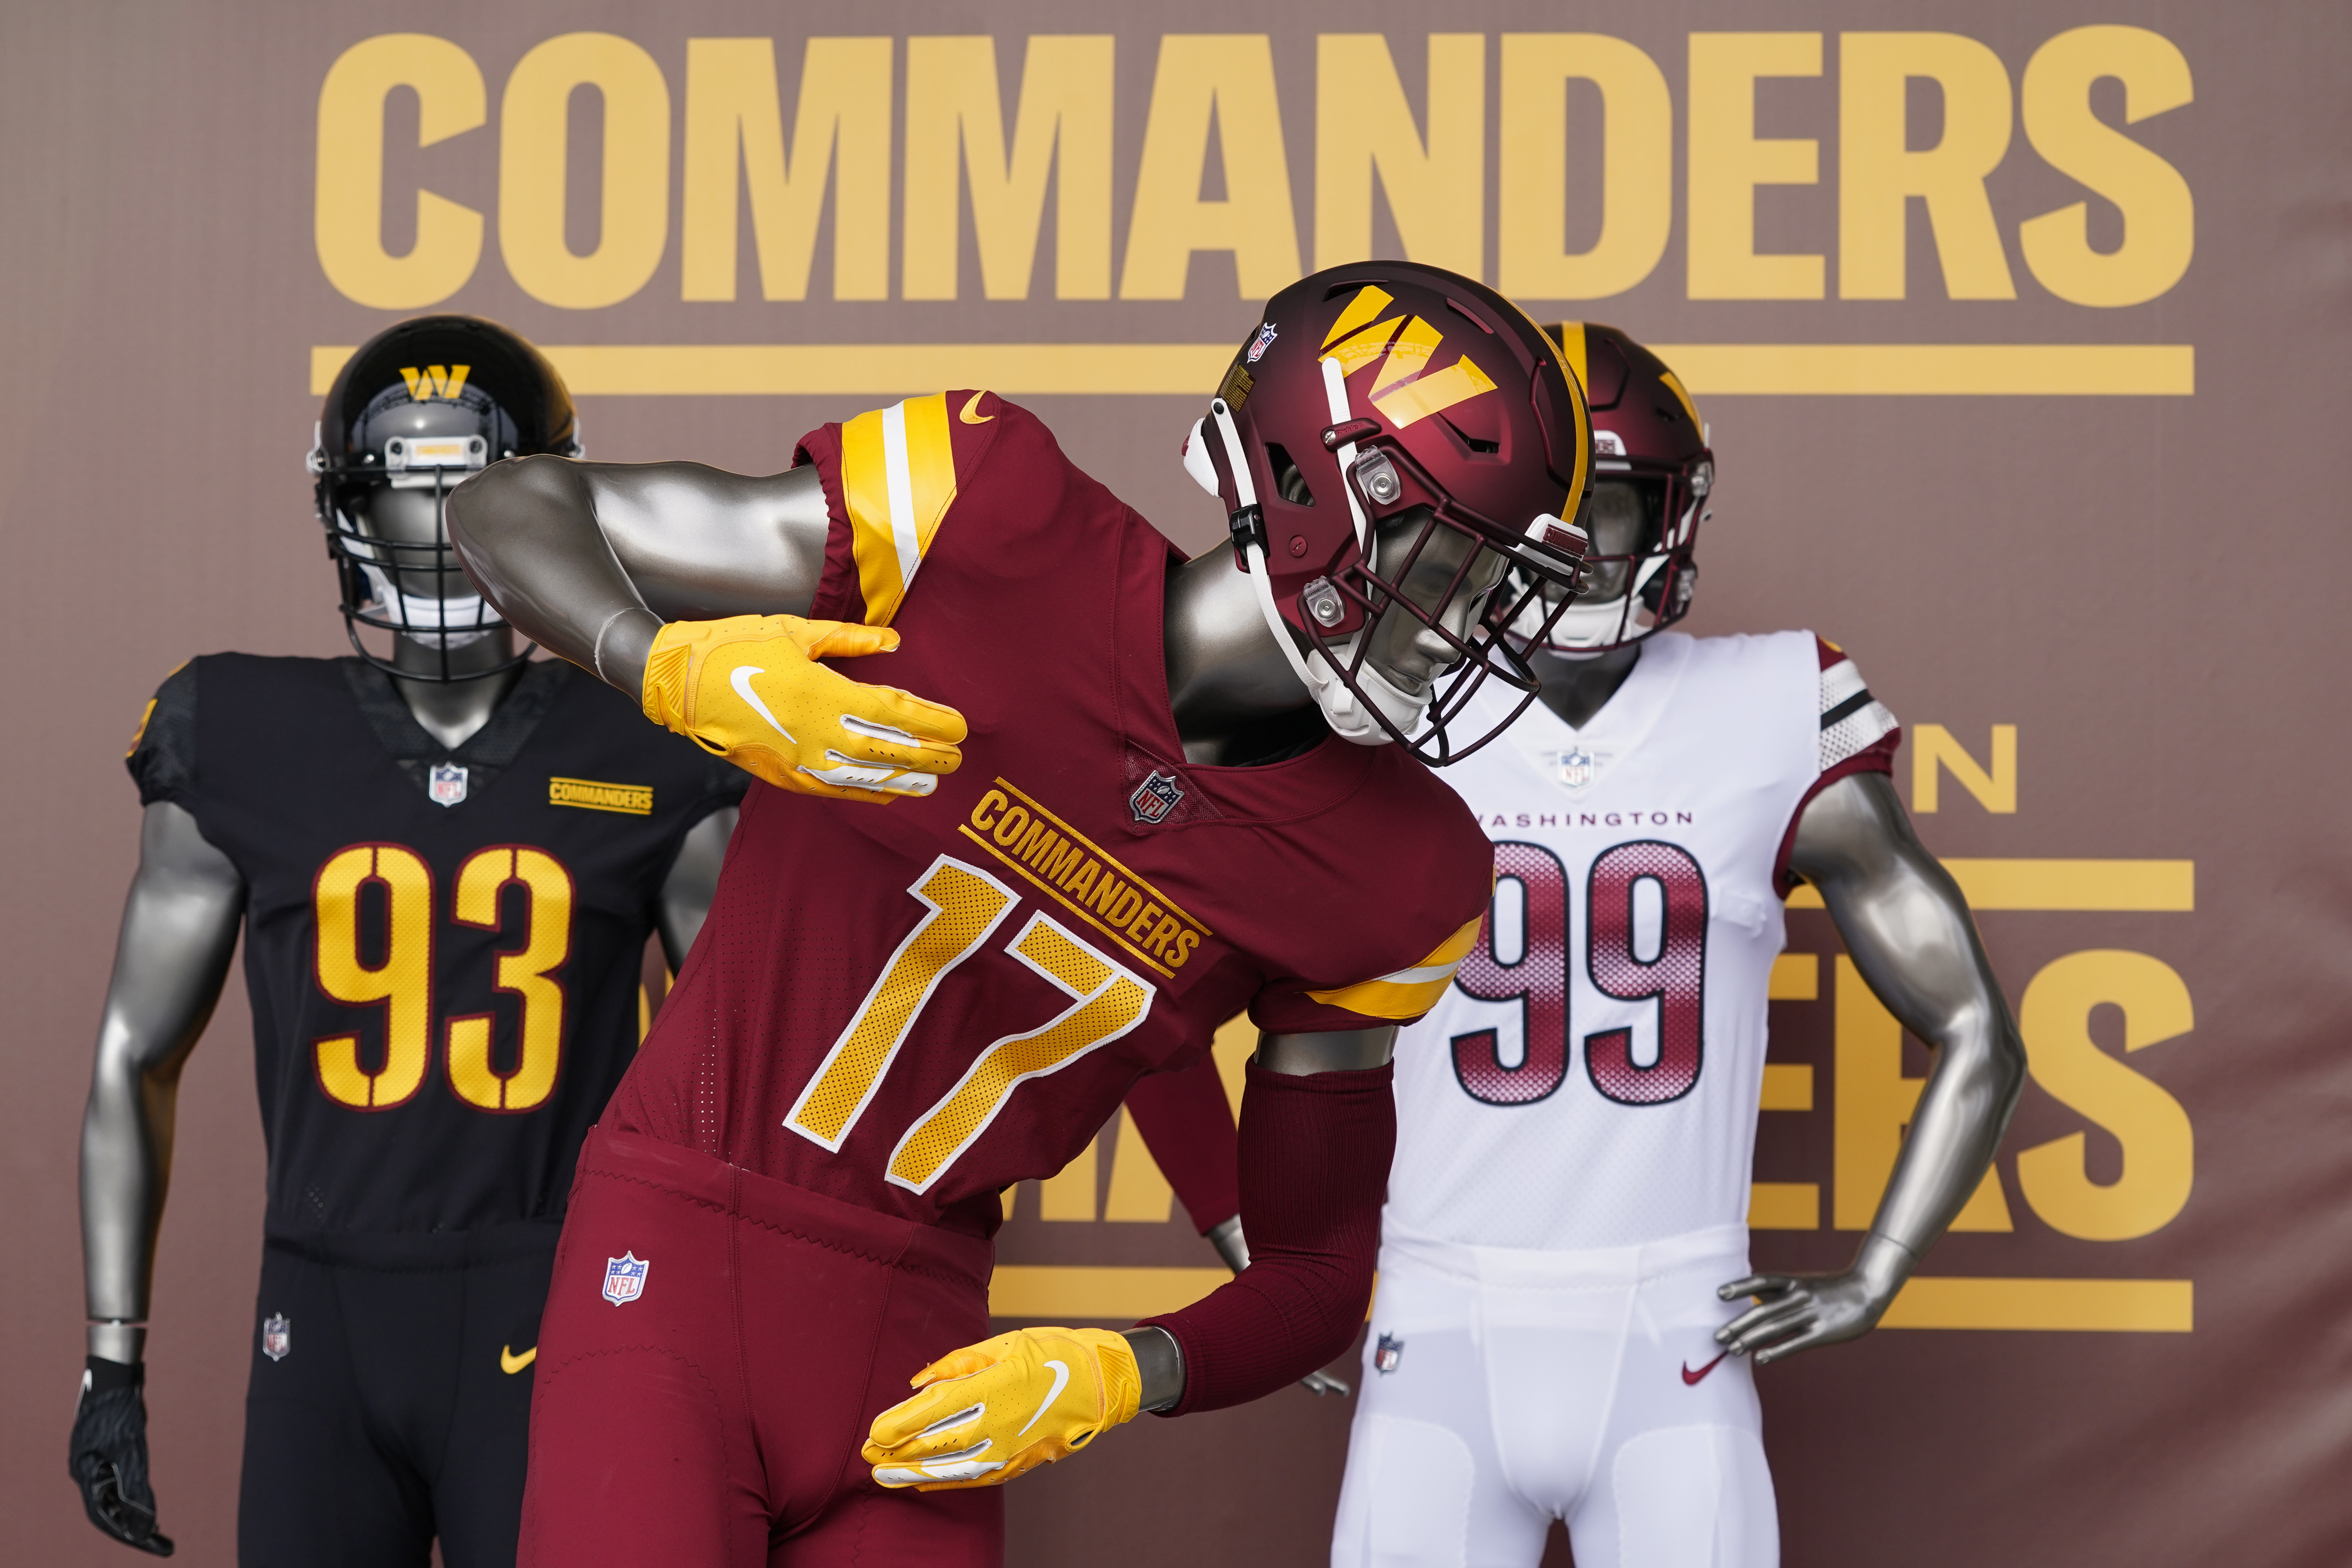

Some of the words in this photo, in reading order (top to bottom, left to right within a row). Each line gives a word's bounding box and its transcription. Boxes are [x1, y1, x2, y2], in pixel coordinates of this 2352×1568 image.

[314, 24, 2195, 309] COMMANDERS
[1251, 339, 1264, 357] NFL
[549, 782, 653, 810] COMMANDERS
[1136, 790, 1165, 818] NFL
[1477, 811, 1694, 828] ASHINGTON
[971, 790, 1201, 968] COMMANDERS
[311, 841, 576, 1114] 93
[782, 853, 1157, 1196] 17
[1450, 840, 1709, 1107] 99
[608, 1277, 635, 1296] NFL
